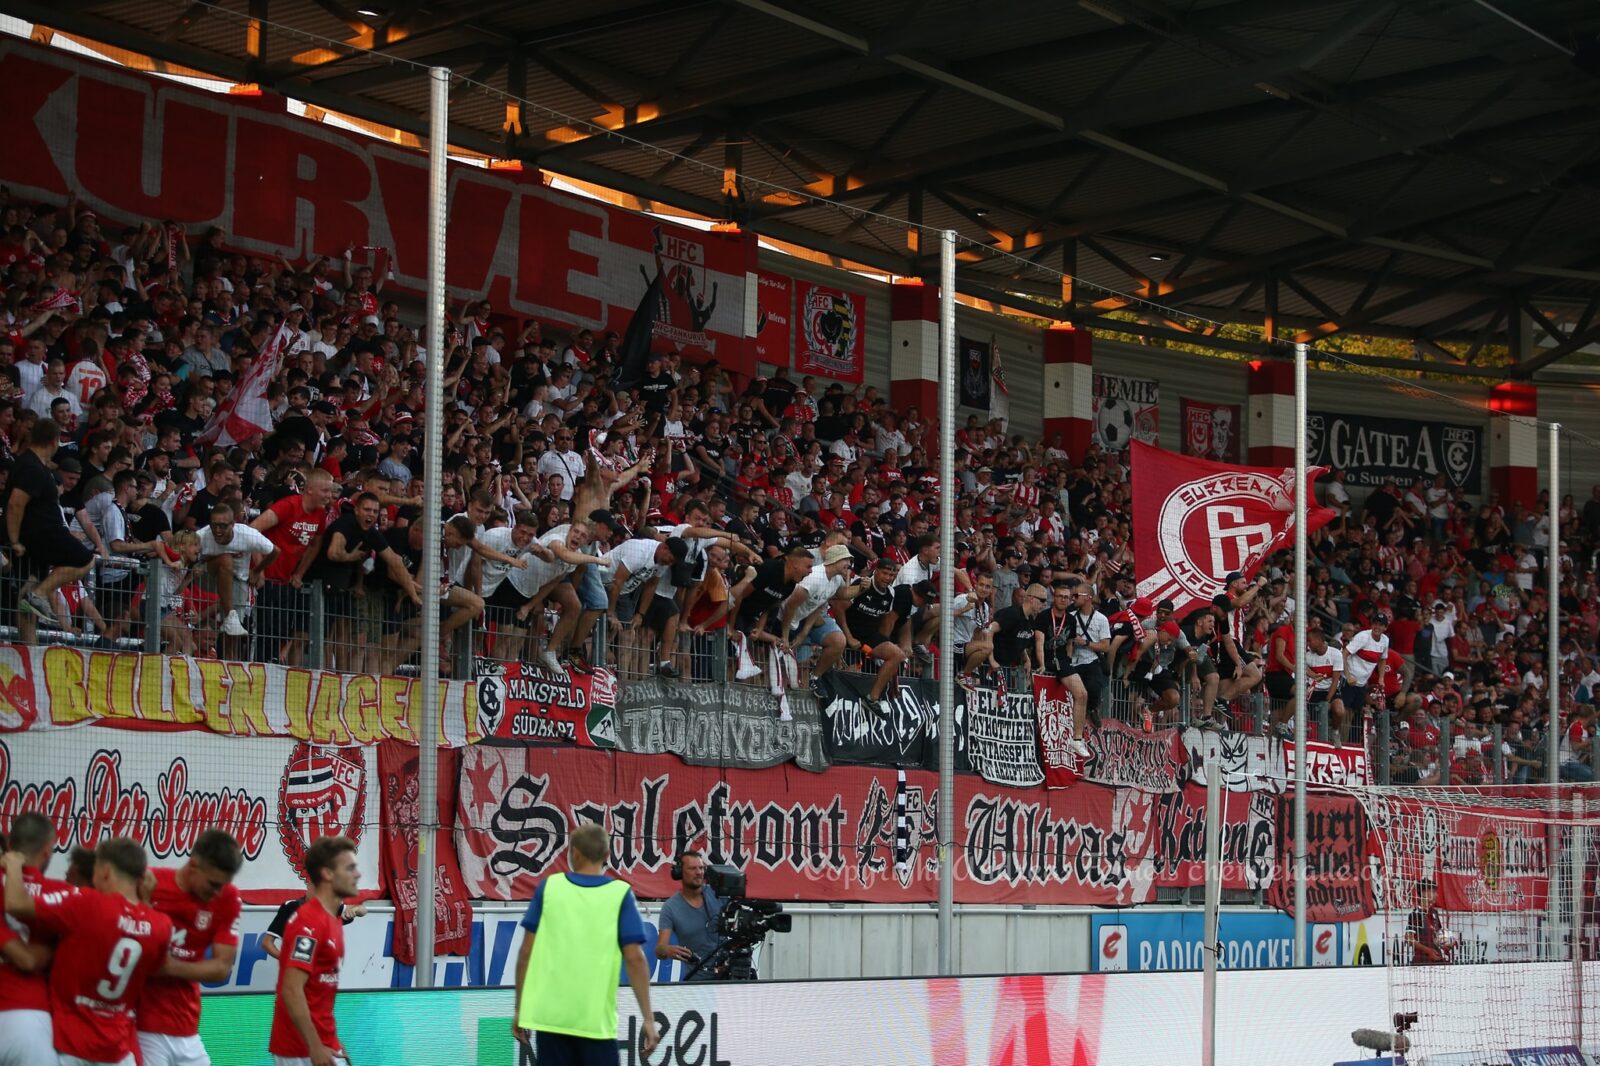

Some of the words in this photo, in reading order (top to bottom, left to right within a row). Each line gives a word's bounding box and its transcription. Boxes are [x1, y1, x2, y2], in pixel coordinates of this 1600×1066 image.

[666, 237, 698, 261] HFC
[1092, 373, 1159, 405] HEMIE
[1329, 418, 1410, 470] GATE
[1411, 425, 1440, 476] A
[1447, 430, 1470, 441] HFC
[1359, 472, 1436, 489] Surene
[1172, 559, 1217, 597] HFC
[43, 646, 276, 737] BULLEN
[508, 679, 586, 709] MANSFELD
[511, 709, 577, 741] SÜDHARZ
[1286, 749, 1366, 786] SRREALE
[97, 937, 143, 999] 9
[1213, 937, 1297, 968] BROCKE
